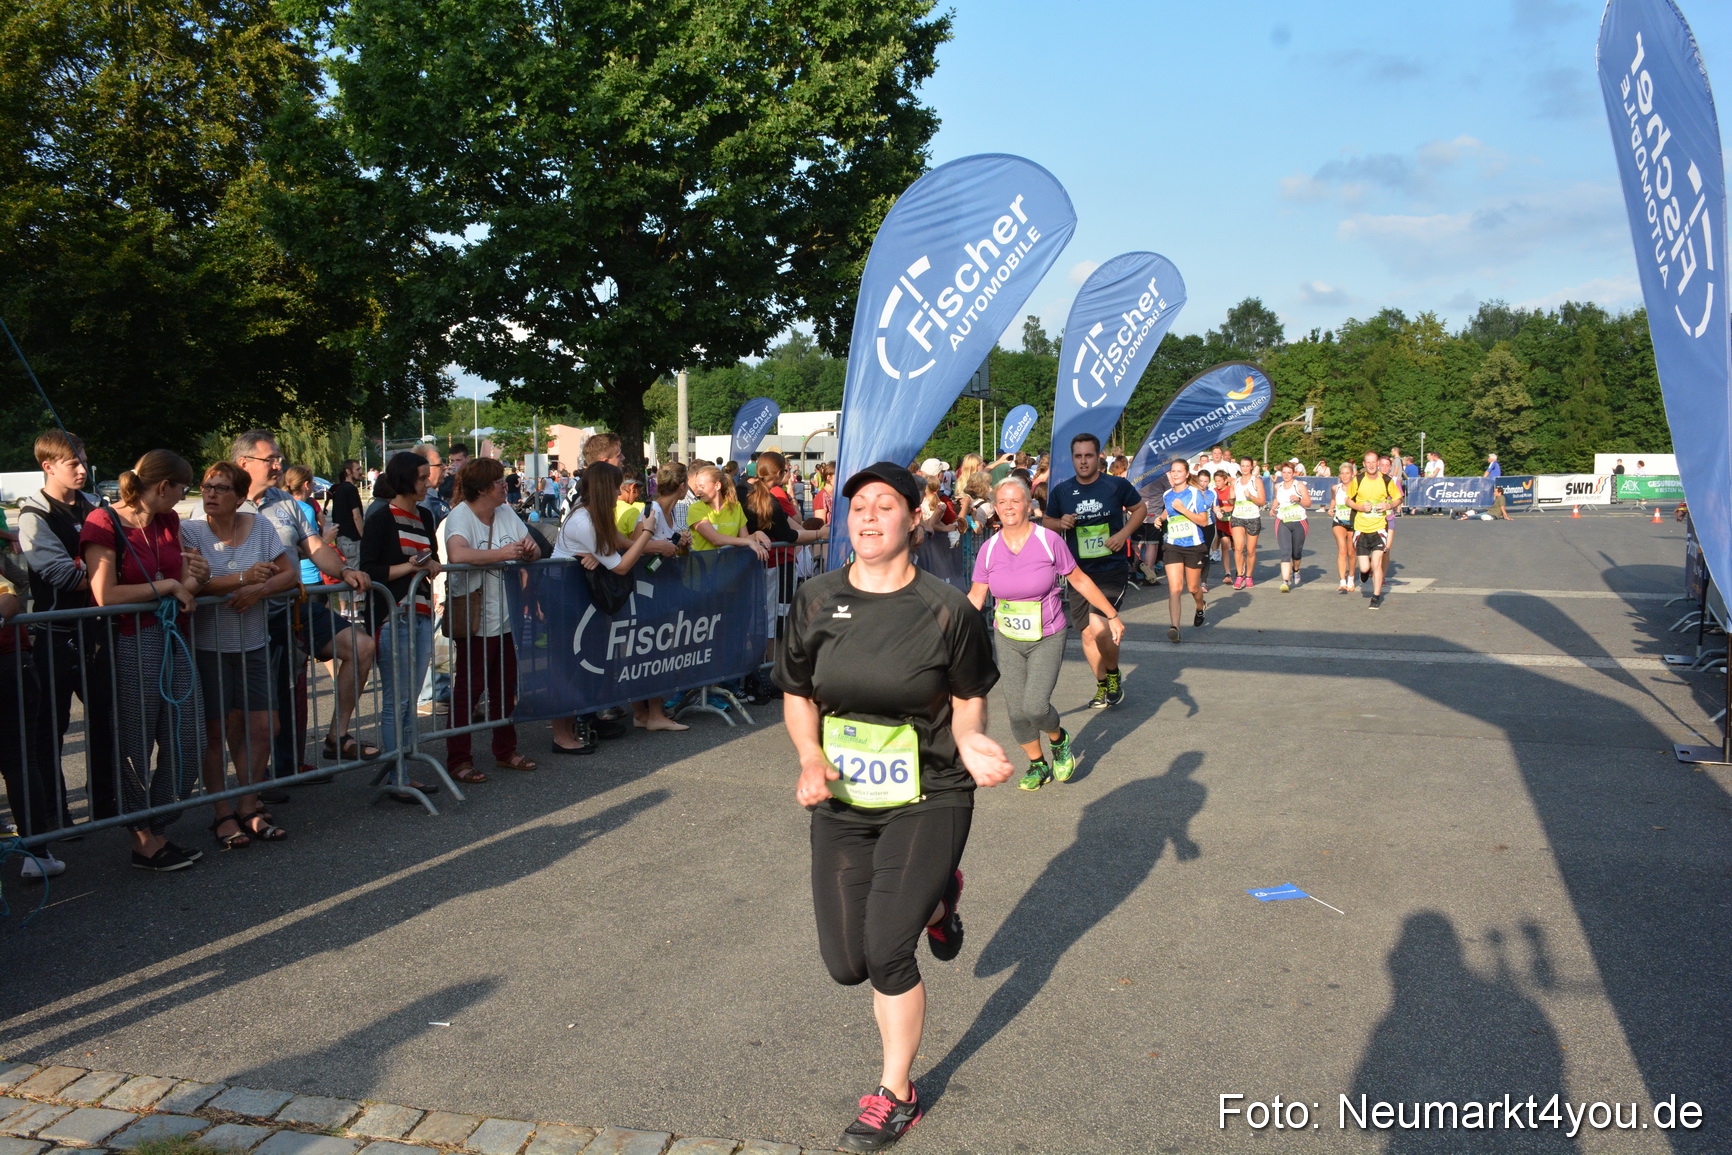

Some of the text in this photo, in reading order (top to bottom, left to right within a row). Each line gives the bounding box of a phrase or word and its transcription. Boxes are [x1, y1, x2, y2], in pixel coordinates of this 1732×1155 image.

[906, 194, 1028, 353] Fischer
[949, 226, 1041, 352] AUTOMOBILE
[1090, 277, 1159, 389] Fischer
[1113, 298, 1167, 388] AUTOMOBILE
[742, 405, 770, 443] Fischer
[1009, 411, 1030, 444] Fischer
[1148, 400, 1237, 455] Frischmann
[1205, 395, 1267, 433] Druck und Medien
[1435, 488, 1480, 499] Fischer
[1620, 479, 1640, 491] AOK
[1647, 480, 1683, 488] GESUNDH
[1084, 537, 1104, 549] 175
[1170, 522, 1190, 534] 1138
[606, 610, 722, 661] Fischer
[1003, 616, 1031, 631] 330
[617, 648, 712, 683] AUTOMOBILE
[833, 754, 909, 784] 1206
